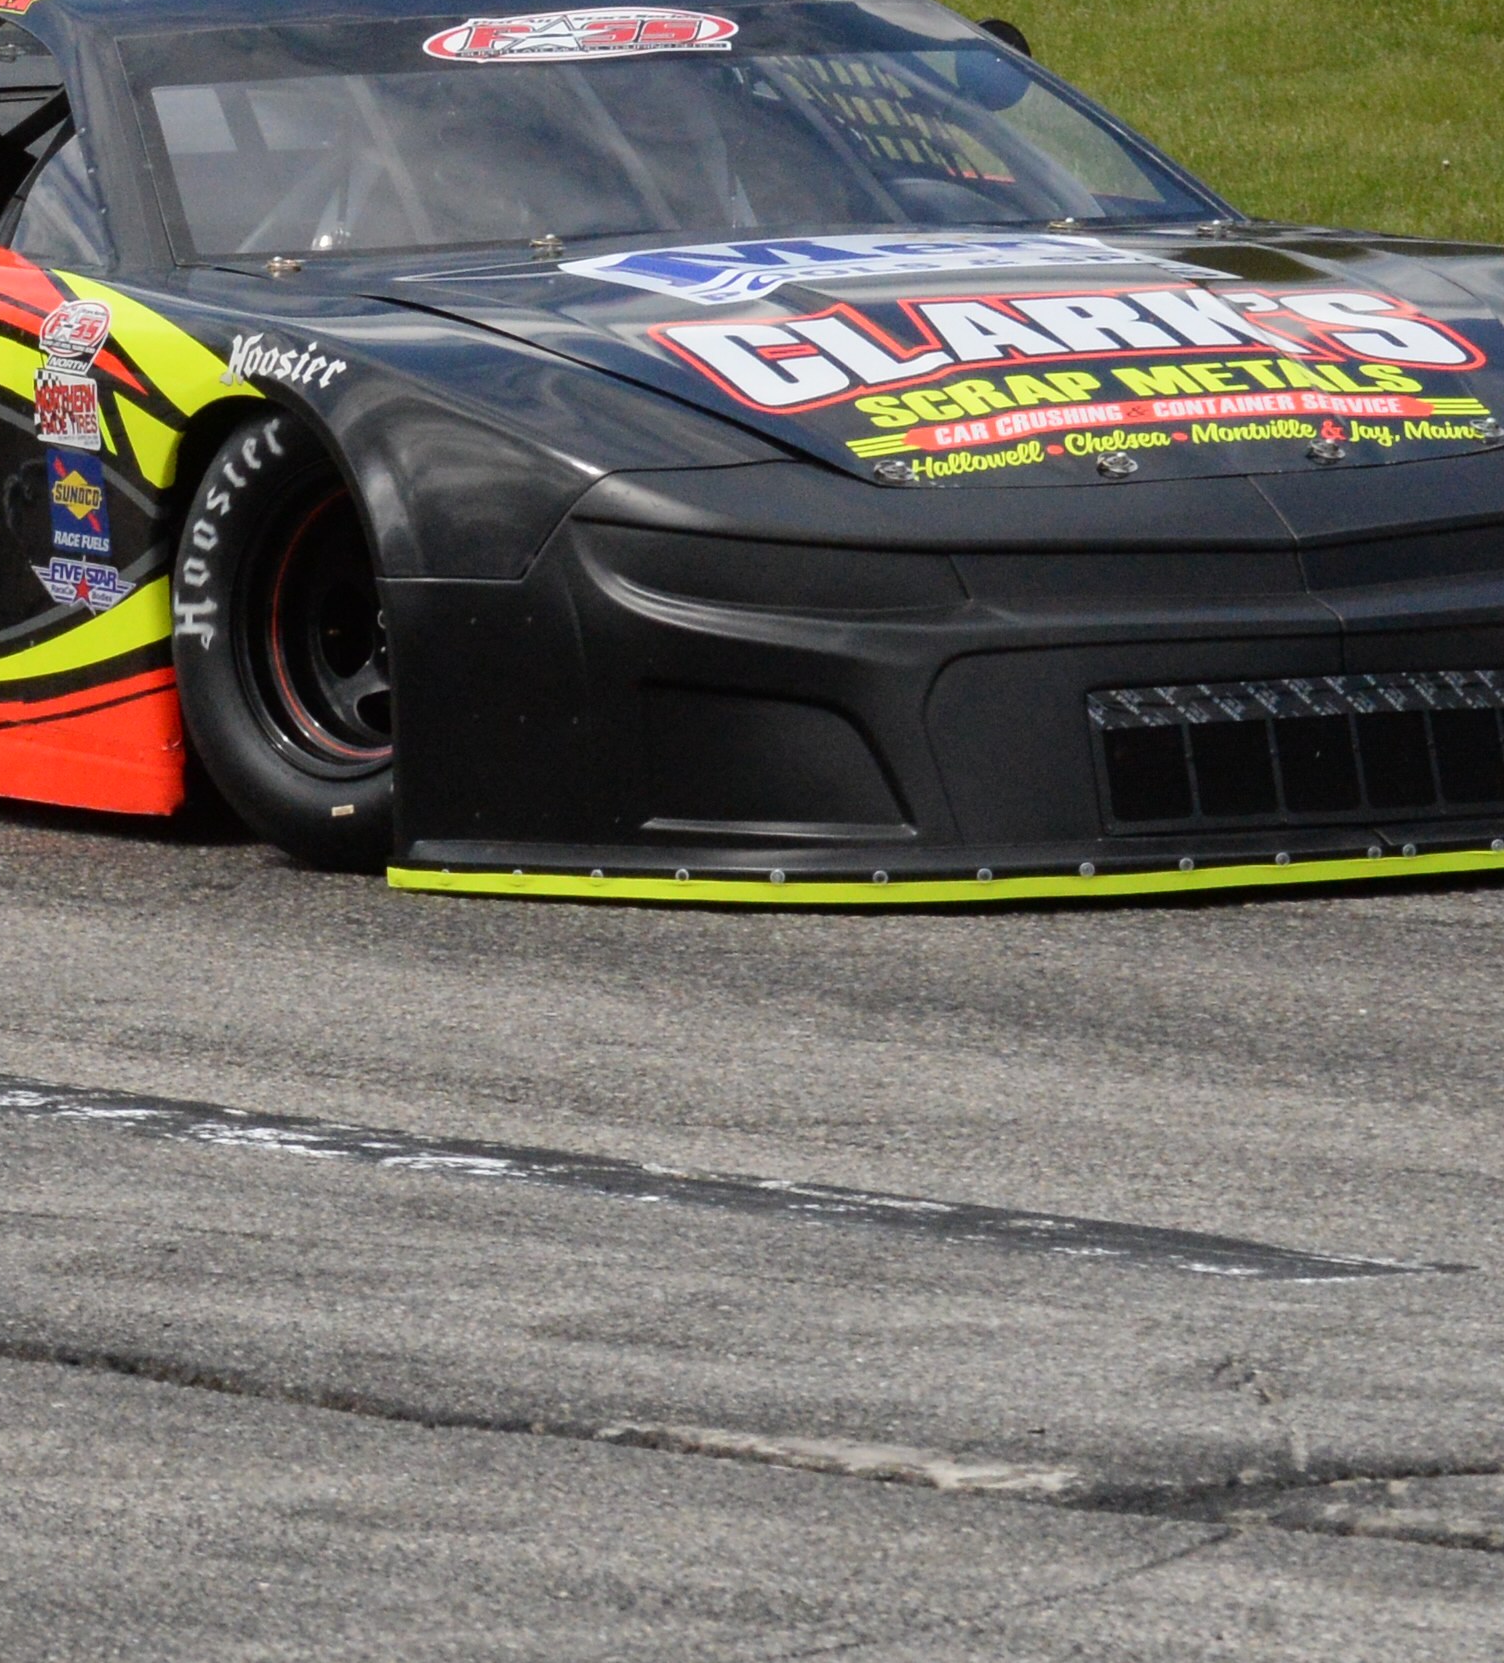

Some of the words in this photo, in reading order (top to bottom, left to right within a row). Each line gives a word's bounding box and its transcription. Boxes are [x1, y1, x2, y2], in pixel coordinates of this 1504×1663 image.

[49, 356, 89, 372] NORTH
[219, 333, 347, 388] Hoosier
[666, 289, 1467, 406] CLARK'S
[854, 372, 1102, 428] SCRAP
[1111, 358, 1423, 397] METALS
[934, 423, 990, 446] CAR
[995, 403, 1124, 437] CRUSHING
[1126, 405, 1147, 419] &
[1153, 395, 1295, 419] CONTAINER
[1302, 392, 1404, 414] SERVICE
[912, 440, 1045, 481] Hallowell
[1064, 430, 1171, 456] Chelsea
[1191, 418, 1318, 445] Montville
[1321, 420, 1345, 441] &
[1349, 419, 1400, 448] Jay,
[55, 484, 101, 507] SUNOCO
[54, 531, 80, 548] RACE
[81, 534, 110, 552] FUELS
[174, 418, 284, 650] Hoosier
[50, 563, 82, 583] FIVE
[85, 567, 117, 592] STAR
